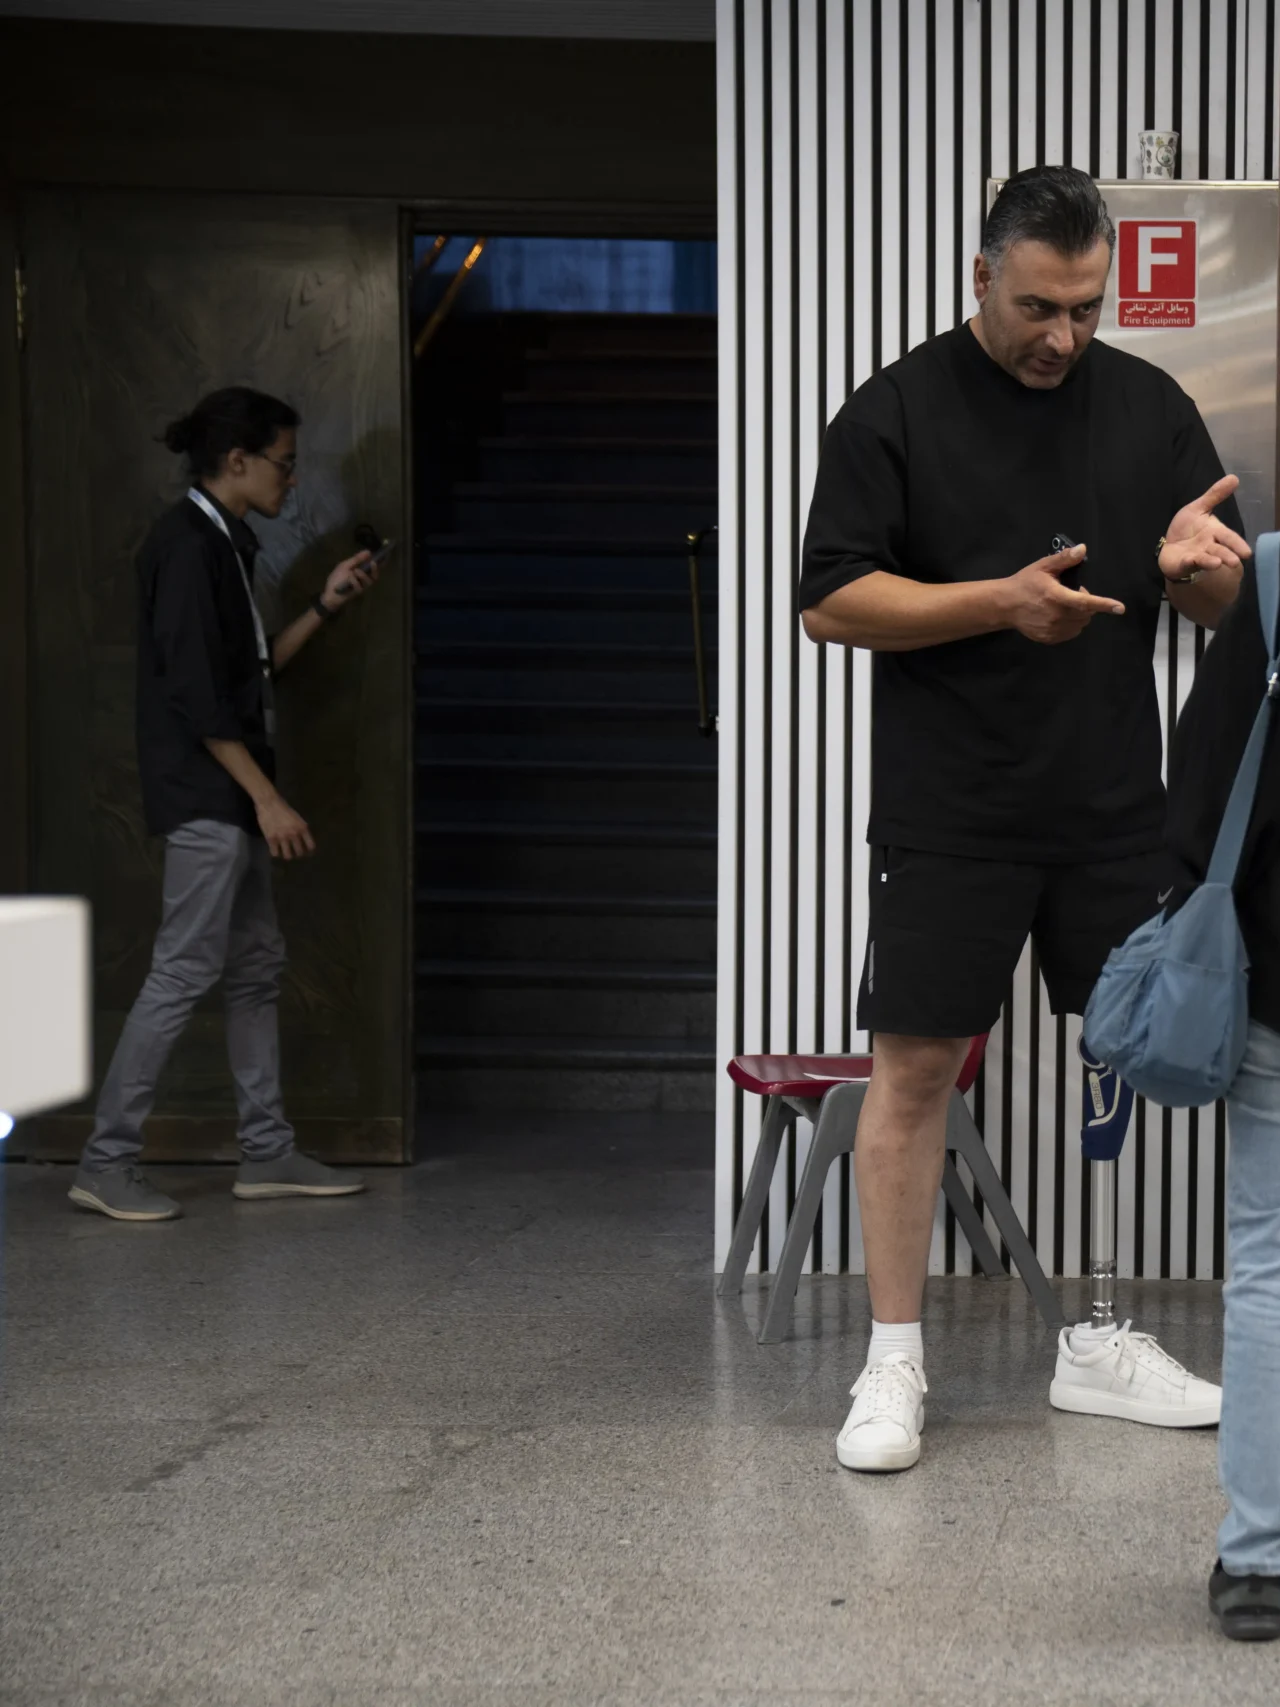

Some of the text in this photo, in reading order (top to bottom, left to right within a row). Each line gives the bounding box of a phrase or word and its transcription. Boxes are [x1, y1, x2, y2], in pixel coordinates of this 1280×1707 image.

[1137, 226, 1182, 293] F
[1123, 316, 1191, 326] Fire Equipment
